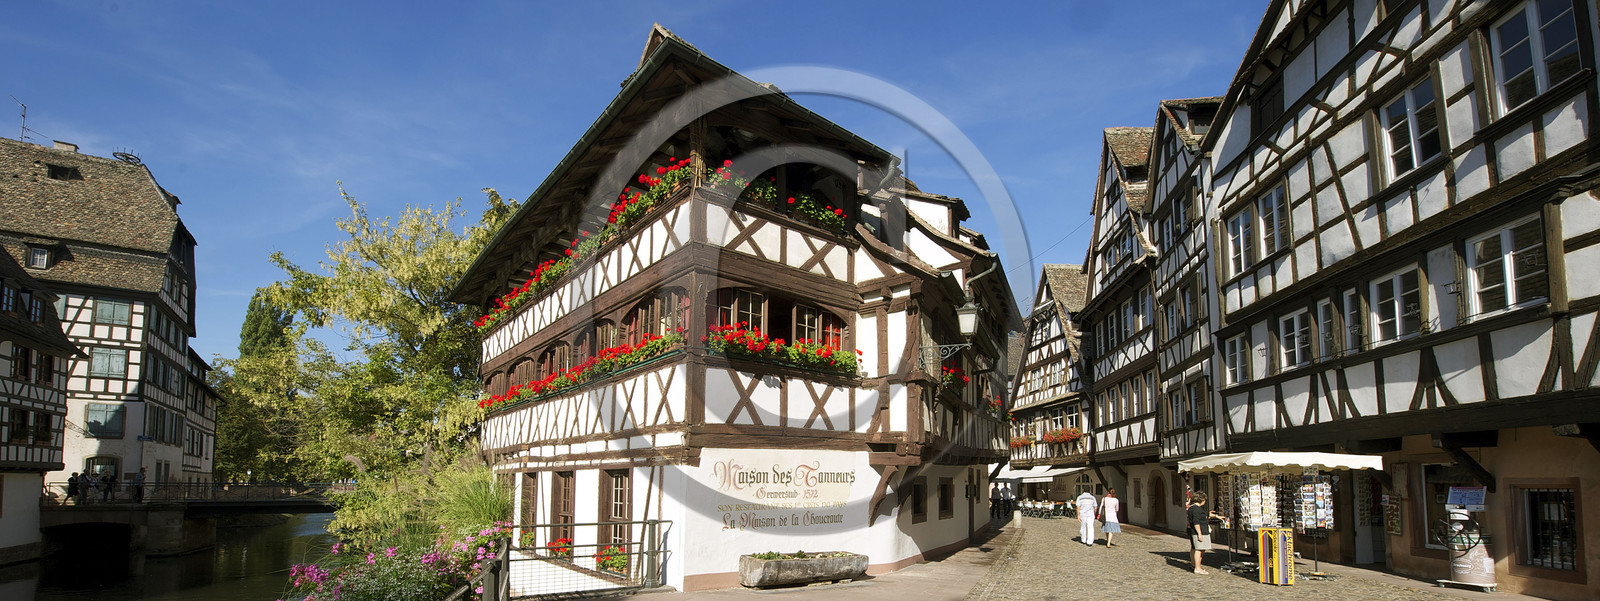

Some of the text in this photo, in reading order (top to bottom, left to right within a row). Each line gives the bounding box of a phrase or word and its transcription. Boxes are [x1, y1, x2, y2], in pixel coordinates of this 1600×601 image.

[713, 459, 856, 491] Maison des Tanneurs
[802, 489, 819, 499] 1572
[717, 504, 733, 512] SON
[735, 502, 779, 511] RESTAURANT
[722, 510, 843, 531] La Maison de la Choucroute
